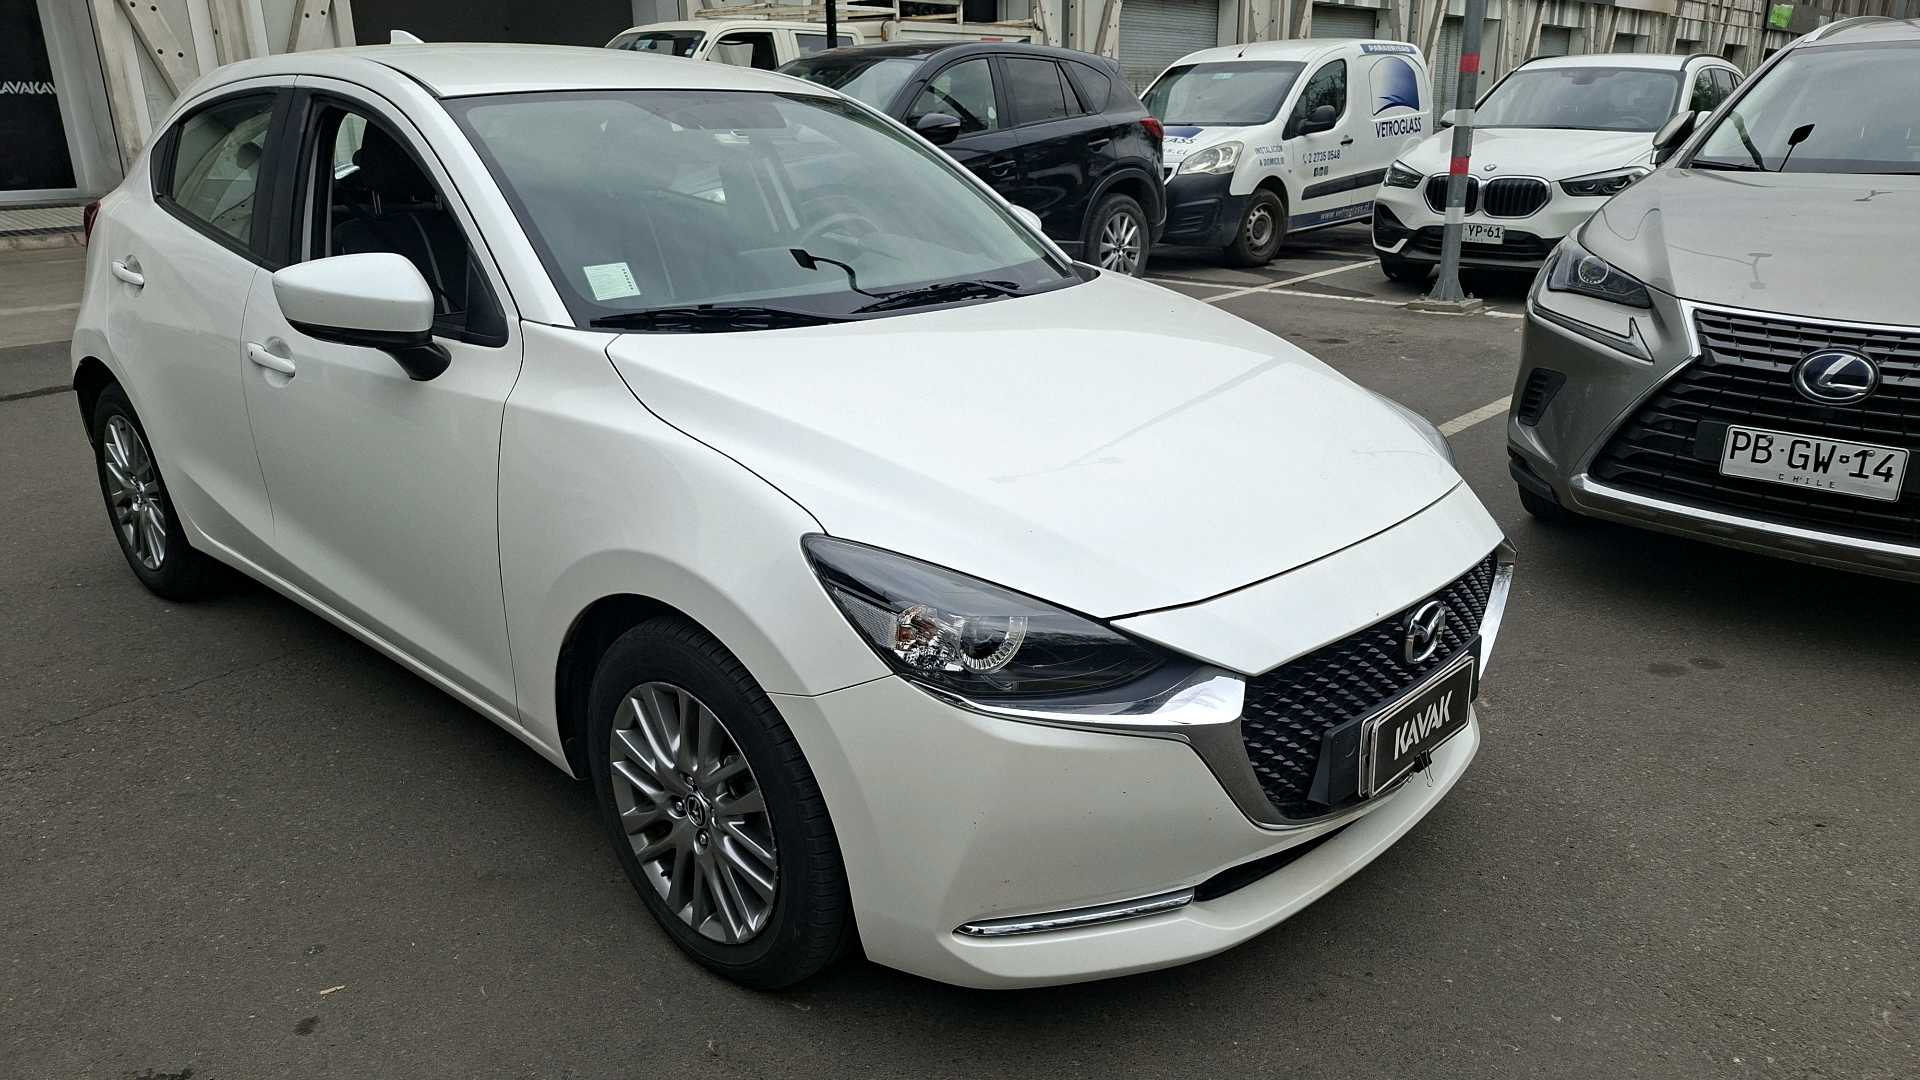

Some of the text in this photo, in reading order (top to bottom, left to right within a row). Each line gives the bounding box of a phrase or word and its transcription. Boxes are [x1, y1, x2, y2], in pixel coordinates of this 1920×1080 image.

[1375, 117, 1422, 138] VETROGLASS
[1313, 151, 1327, 163] 2735
[1328, 149, 1341, 161] 0548
[1778, 473, 1836, 489] CHILE
[1394, 690, 1453, 761] KAVAK
